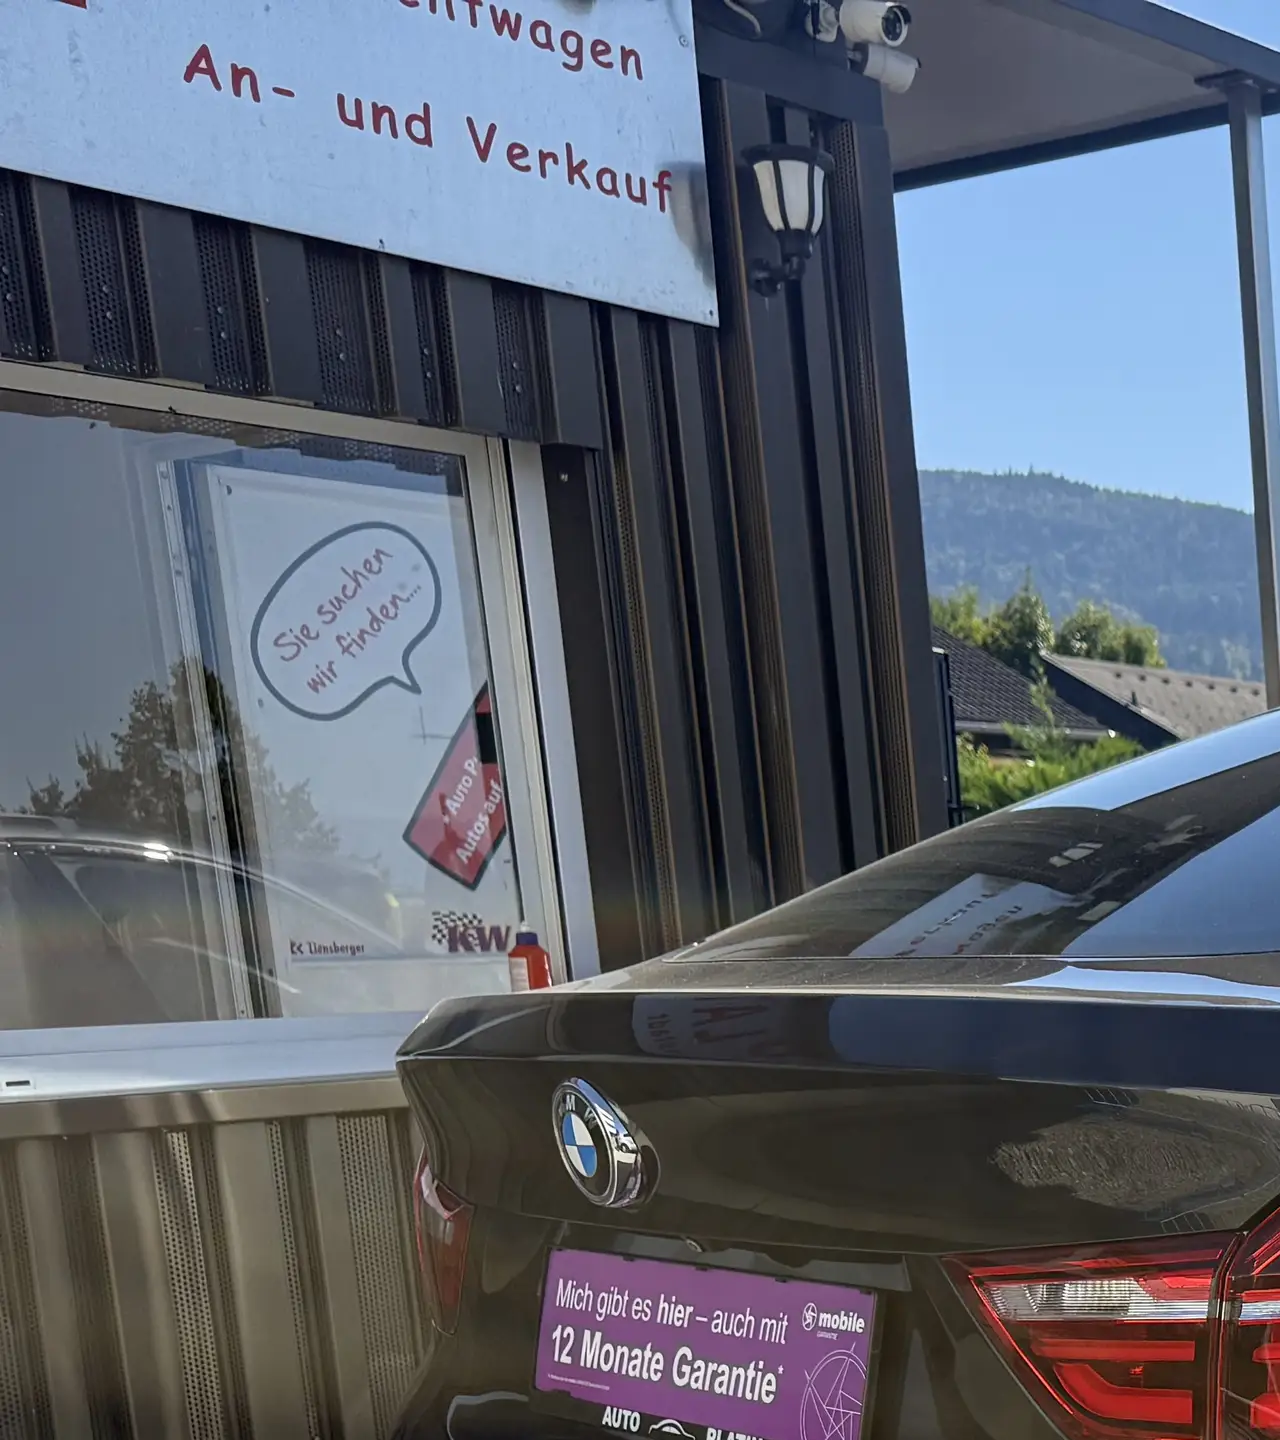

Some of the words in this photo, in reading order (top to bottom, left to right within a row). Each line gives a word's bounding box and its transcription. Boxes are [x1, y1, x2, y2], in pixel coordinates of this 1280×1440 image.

[400, 0, 643, 80] twagen
[184, 44, 295, 103] An-
[337, 93, 433, 148] und
[466, 116, 672, 213] Verkauf
[273, 624, 320, 662] Sie
[317, 548, 393, 625] suchen
[307, 660, 338, 694] wir
[456, 814, 490, 864] Autos
[556, 1278, 593, 1311] Mich
[596, 1286, 629, 1321] gibt
[632, 1297, 652, 1321] es
[656, 1294, 694, 1328] hier
[711, 1308, 755, 1339] auch
[759, 1312, 789, 1344] mit
[818, 1311, 866, 1334] mobile
[552, 1324, 574, 1364] 12
[580, 1329, 664, 1382] Monate
[602, 1406, 641, 1432] AUTO
